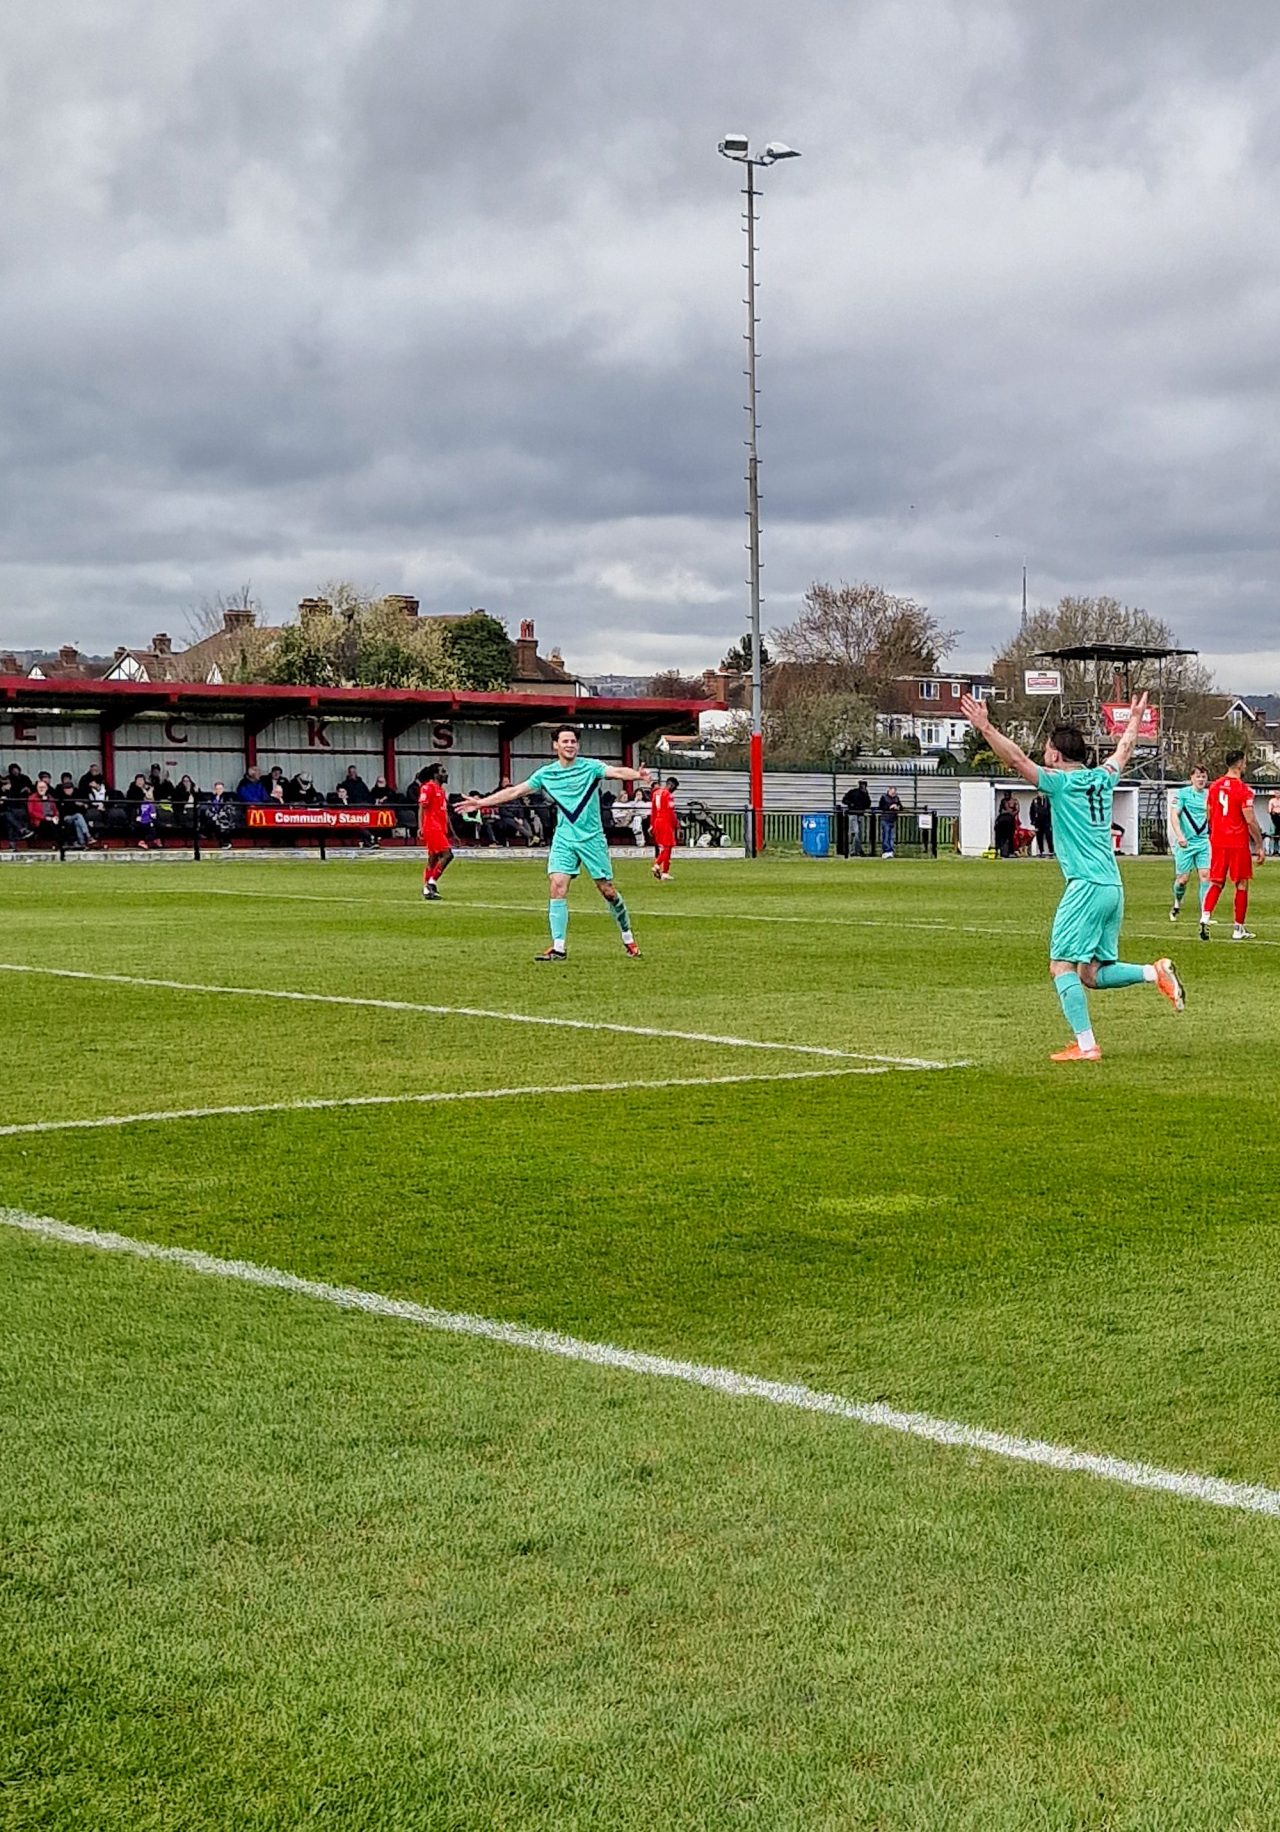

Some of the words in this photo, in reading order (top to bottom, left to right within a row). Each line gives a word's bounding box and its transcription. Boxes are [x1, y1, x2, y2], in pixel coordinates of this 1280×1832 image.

[165, 716, 189, 743] C
[307, 721, 331, 747] K
[432, 724, 454, 749] S
[1086, 784, 1106, 823] 11
[1218, 790, 1229, 816] 4
[274, 812, 337, 826] Community
[338, 812, 370, 824] Stand
